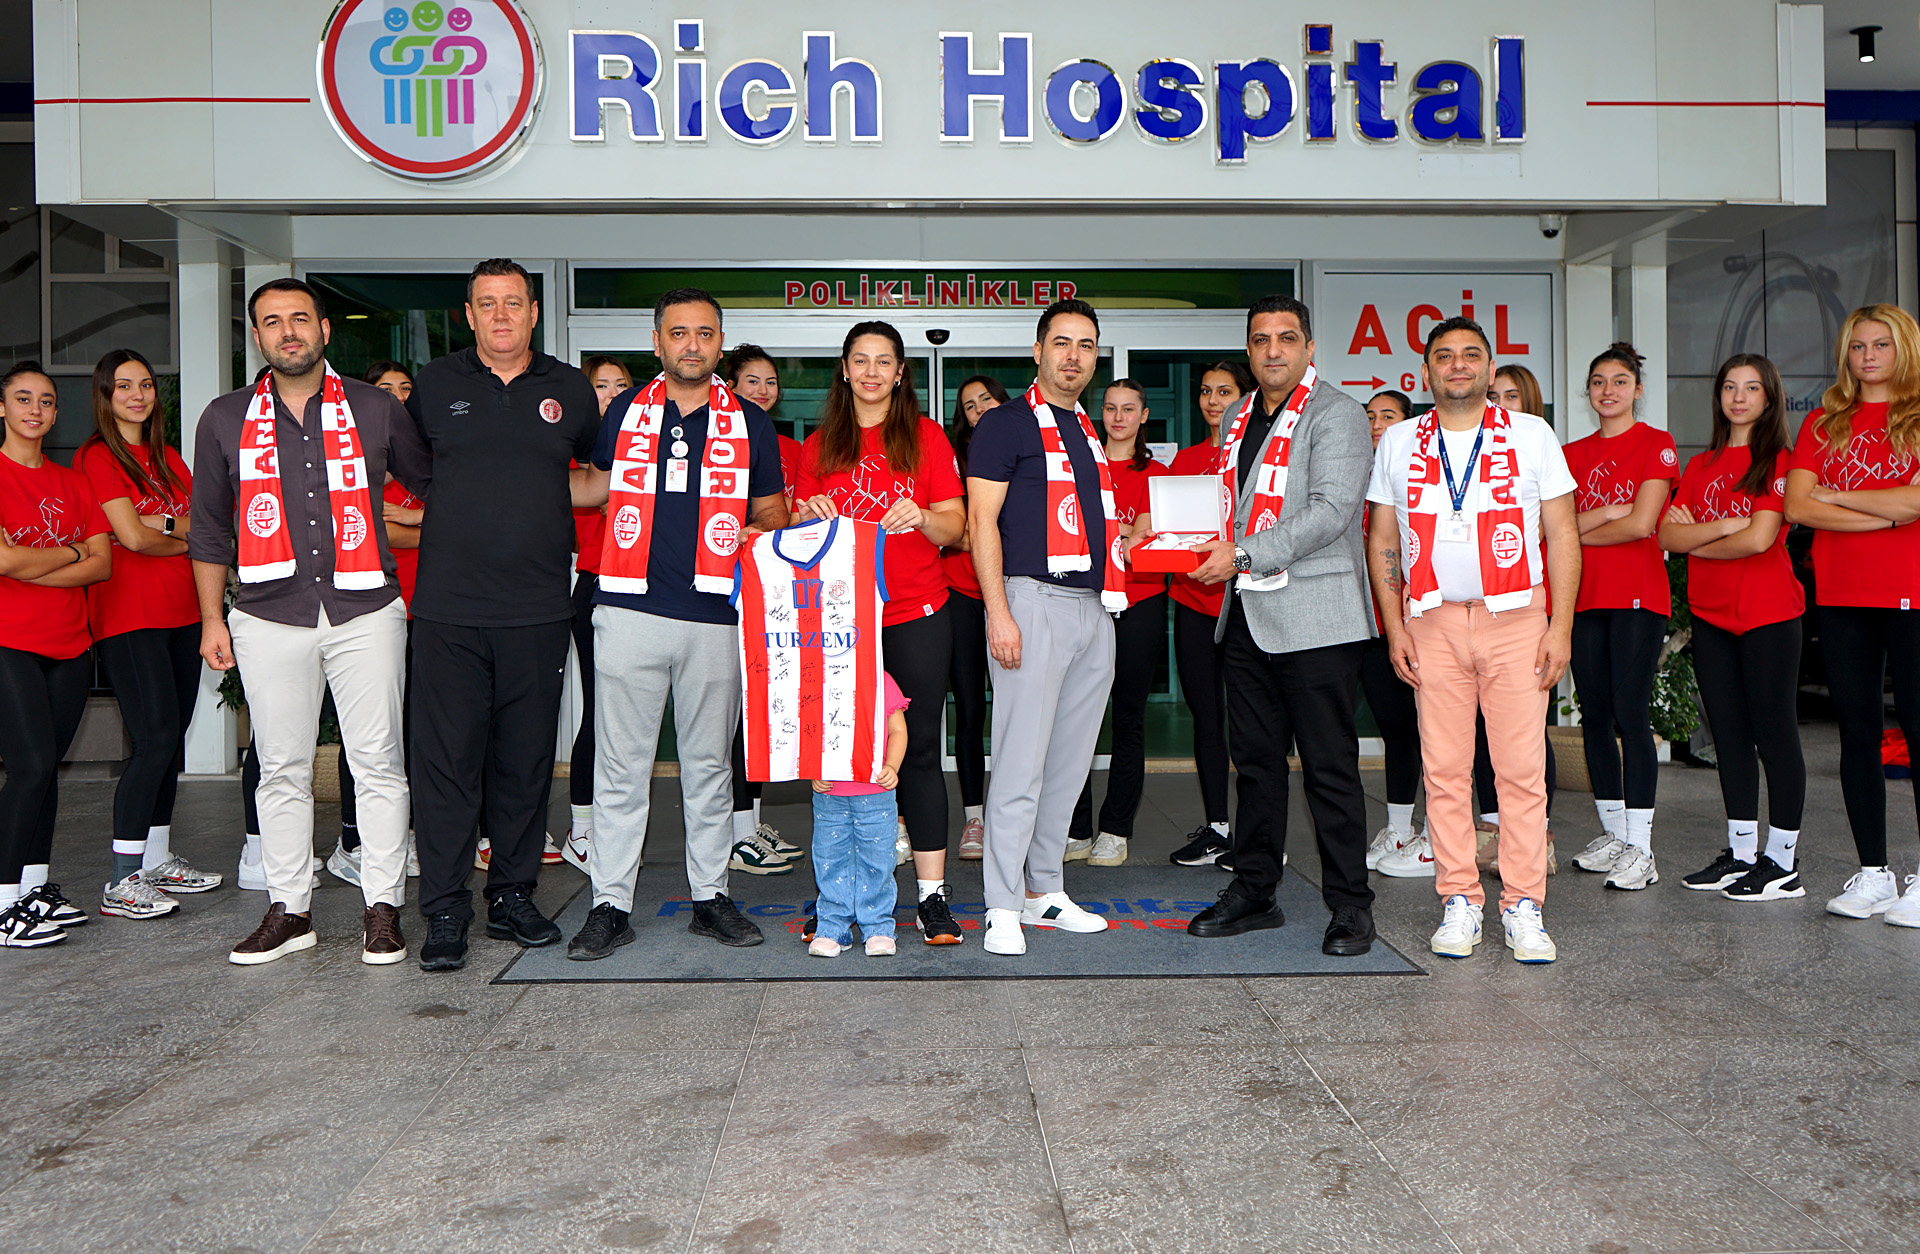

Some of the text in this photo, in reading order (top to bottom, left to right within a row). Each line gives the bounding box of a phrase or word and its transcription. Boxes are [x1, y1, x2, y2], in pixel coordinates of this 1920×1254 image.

[568, 18, 1527, 168] Rich Hospital
[785, 273, 1077, 307] POLİKLİNİKLER
[451, 409, 469, 417] umbro
[792, 578, 825, 609] 07
[760, 631, 852, 649] TURZEM
